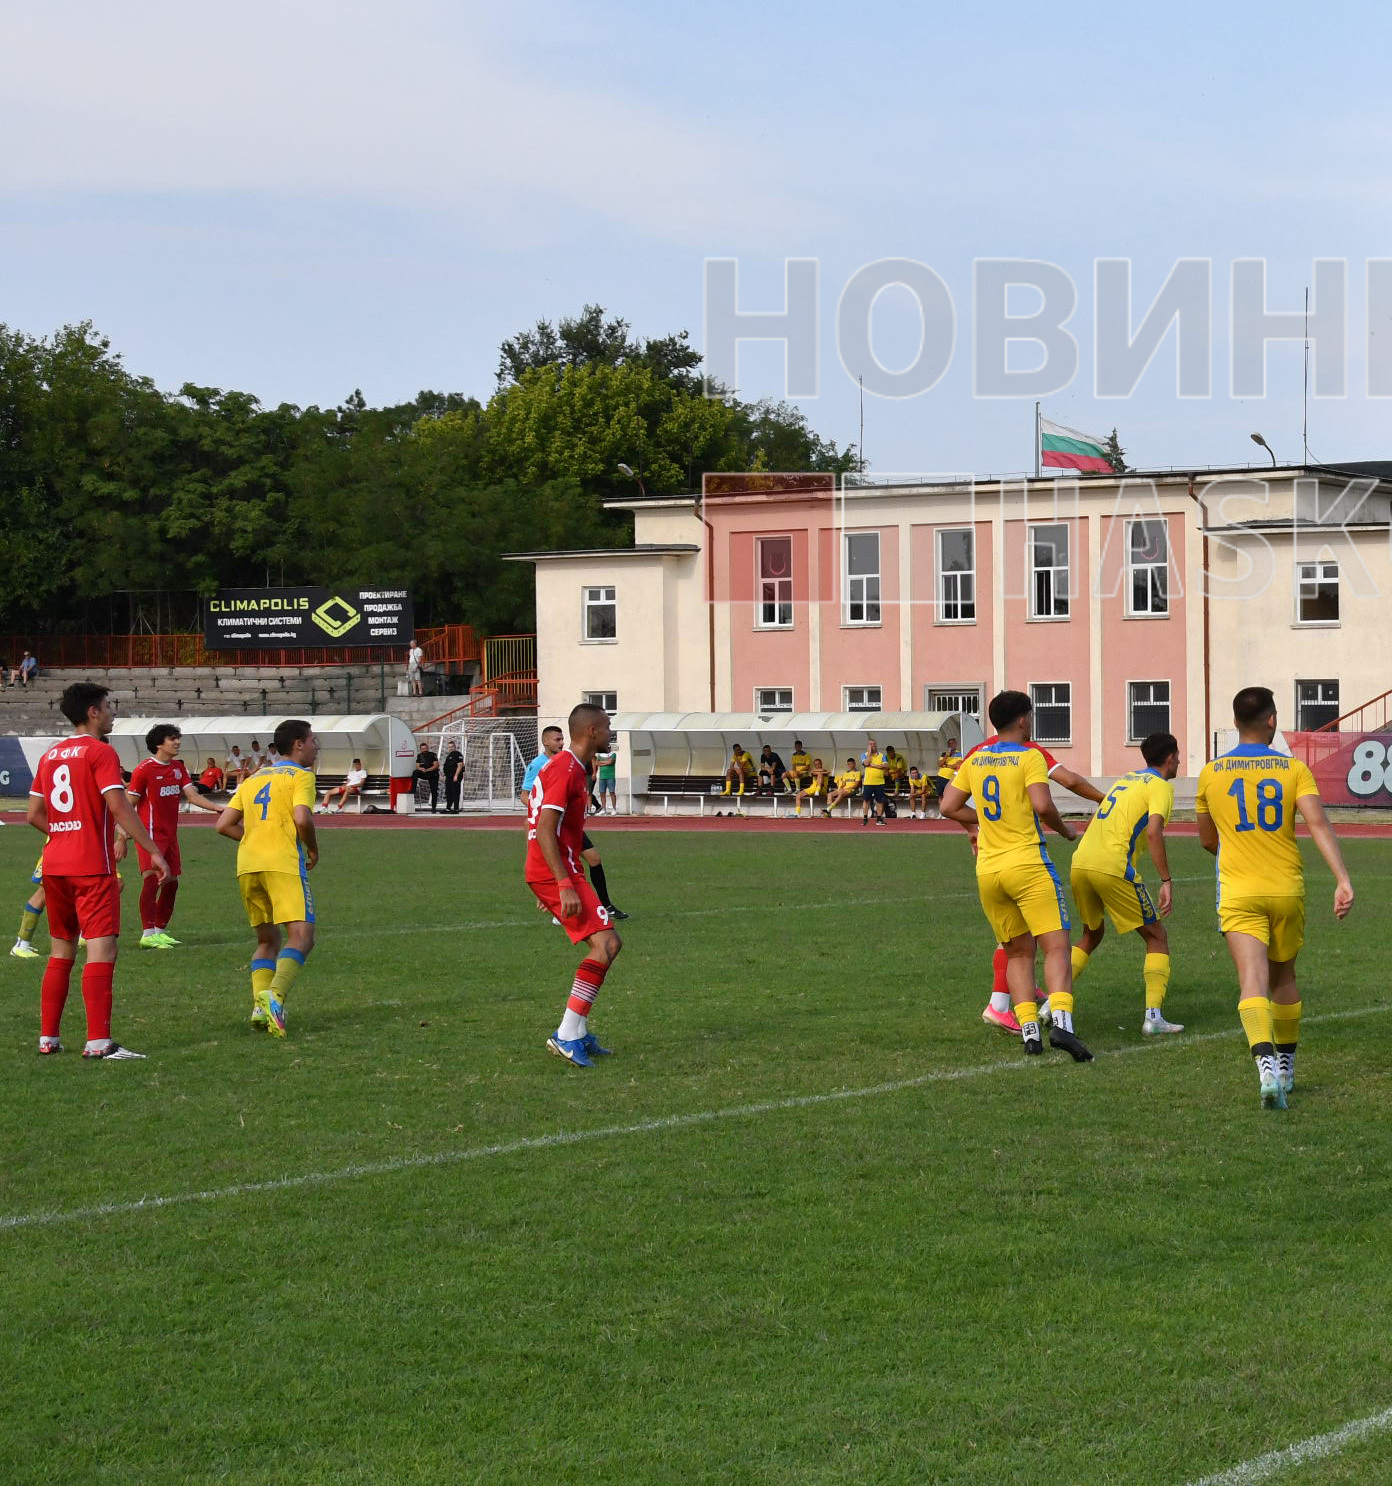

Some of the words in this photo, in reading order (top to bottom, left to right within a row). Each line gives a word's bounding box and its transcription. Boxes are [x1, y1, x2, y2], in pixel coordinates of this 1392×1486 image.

[360, 590, 407, 599] ПРОЕКТИРАНЕ
[210, 598, 309, 612] CLIMAPOLIS
[364, 603, 403, 613] ПРОДАЖБА
[218, 617, 267, 626] КЛИМАТИЧНИ
[268, 616, 302, 625] СИСТЕМИ
[368, 616, 398, 625] МОНТАЖ
[370, 627, 397, 636] СЕРВИЗ
[1225, 758, 1290, 772] ДИМИТРОВГРАД
[50, 764, 74, 813] 8
[253, 781, 271, 820] 4
[982, 775, 1002, 821] 9
[1097, 785, 1128, 820] 5
[1228, 778, 1283, 832] 18
